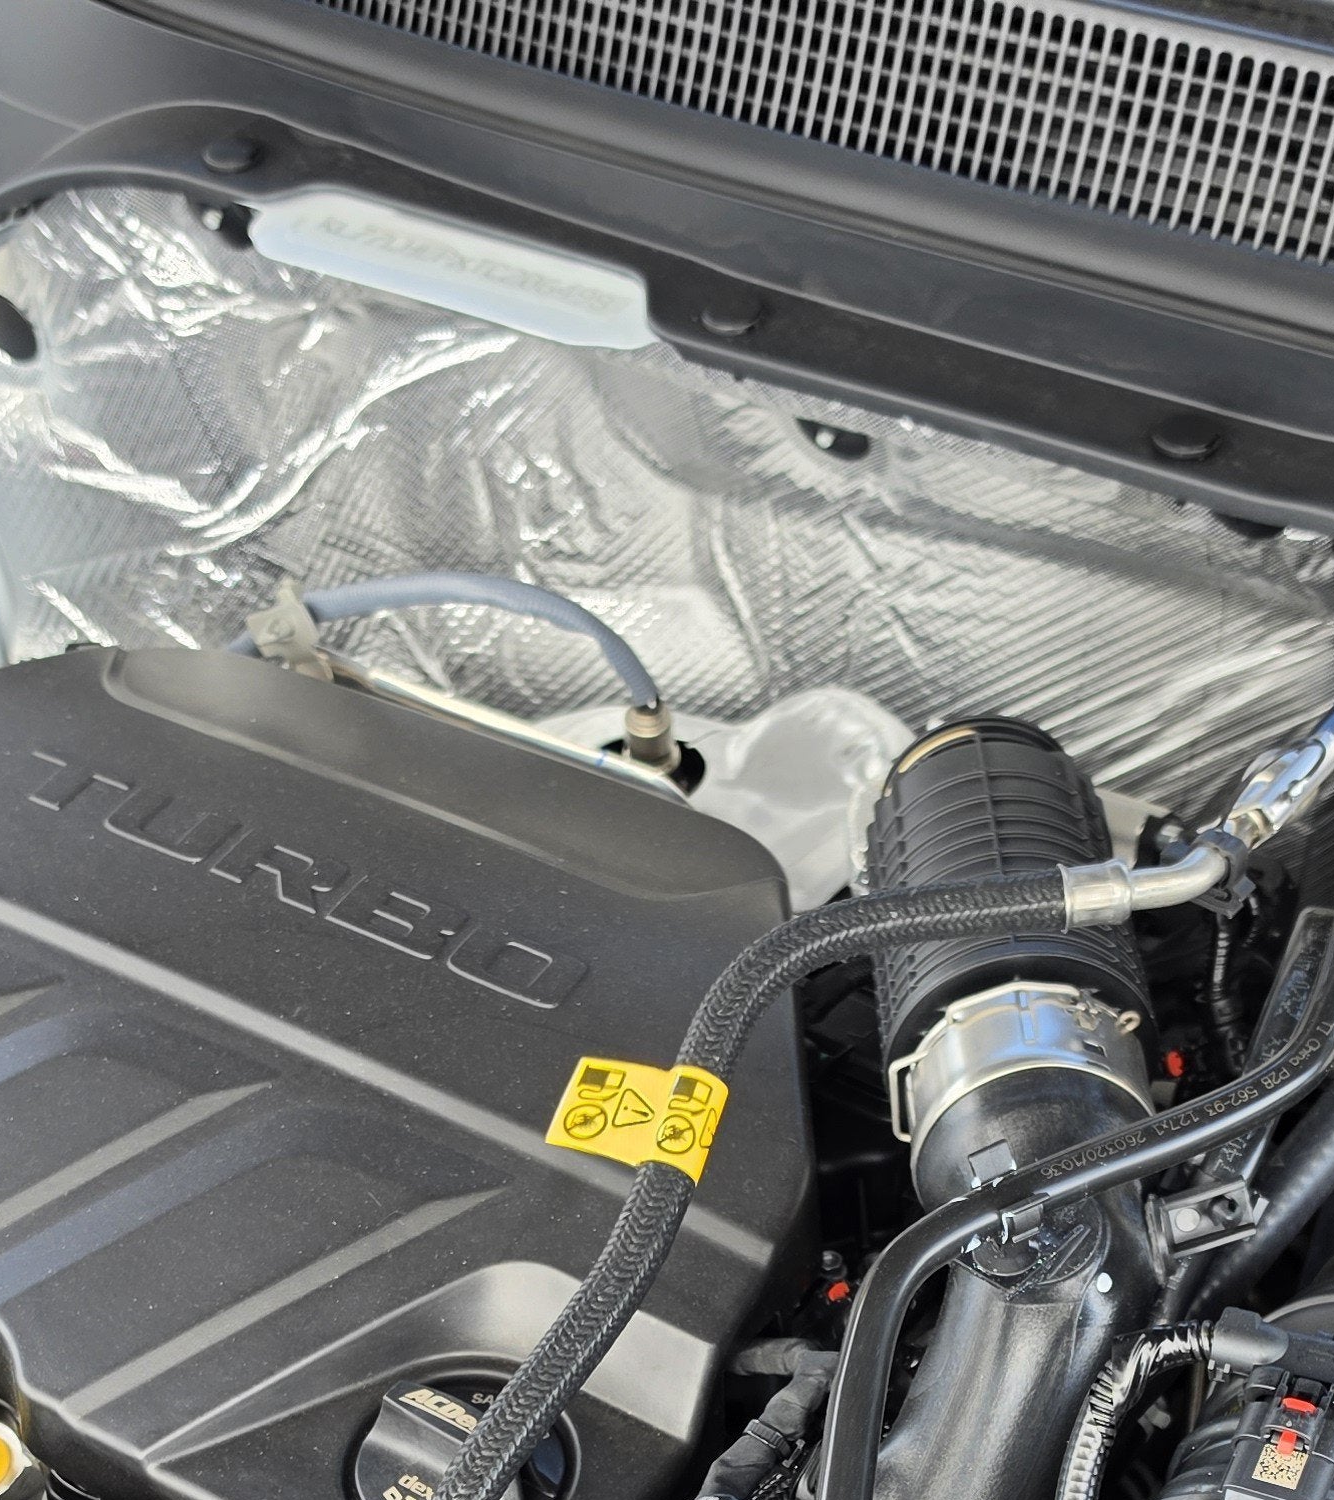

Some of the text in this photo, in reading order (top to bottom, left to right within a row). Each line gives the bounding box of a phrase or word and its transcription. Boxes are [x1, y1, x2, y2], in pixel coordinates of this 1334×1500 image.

[28, 750, 589, 1010] TURBO
[1288, 1036, 1321, 1069] China
[1259, 1065, 1290, 1089] P2B
[1203, 1083, 1259, 1117] 562-93
[399, 1389, 479, 1434] ACDe
[398, 1474, 435, 1500] dex
